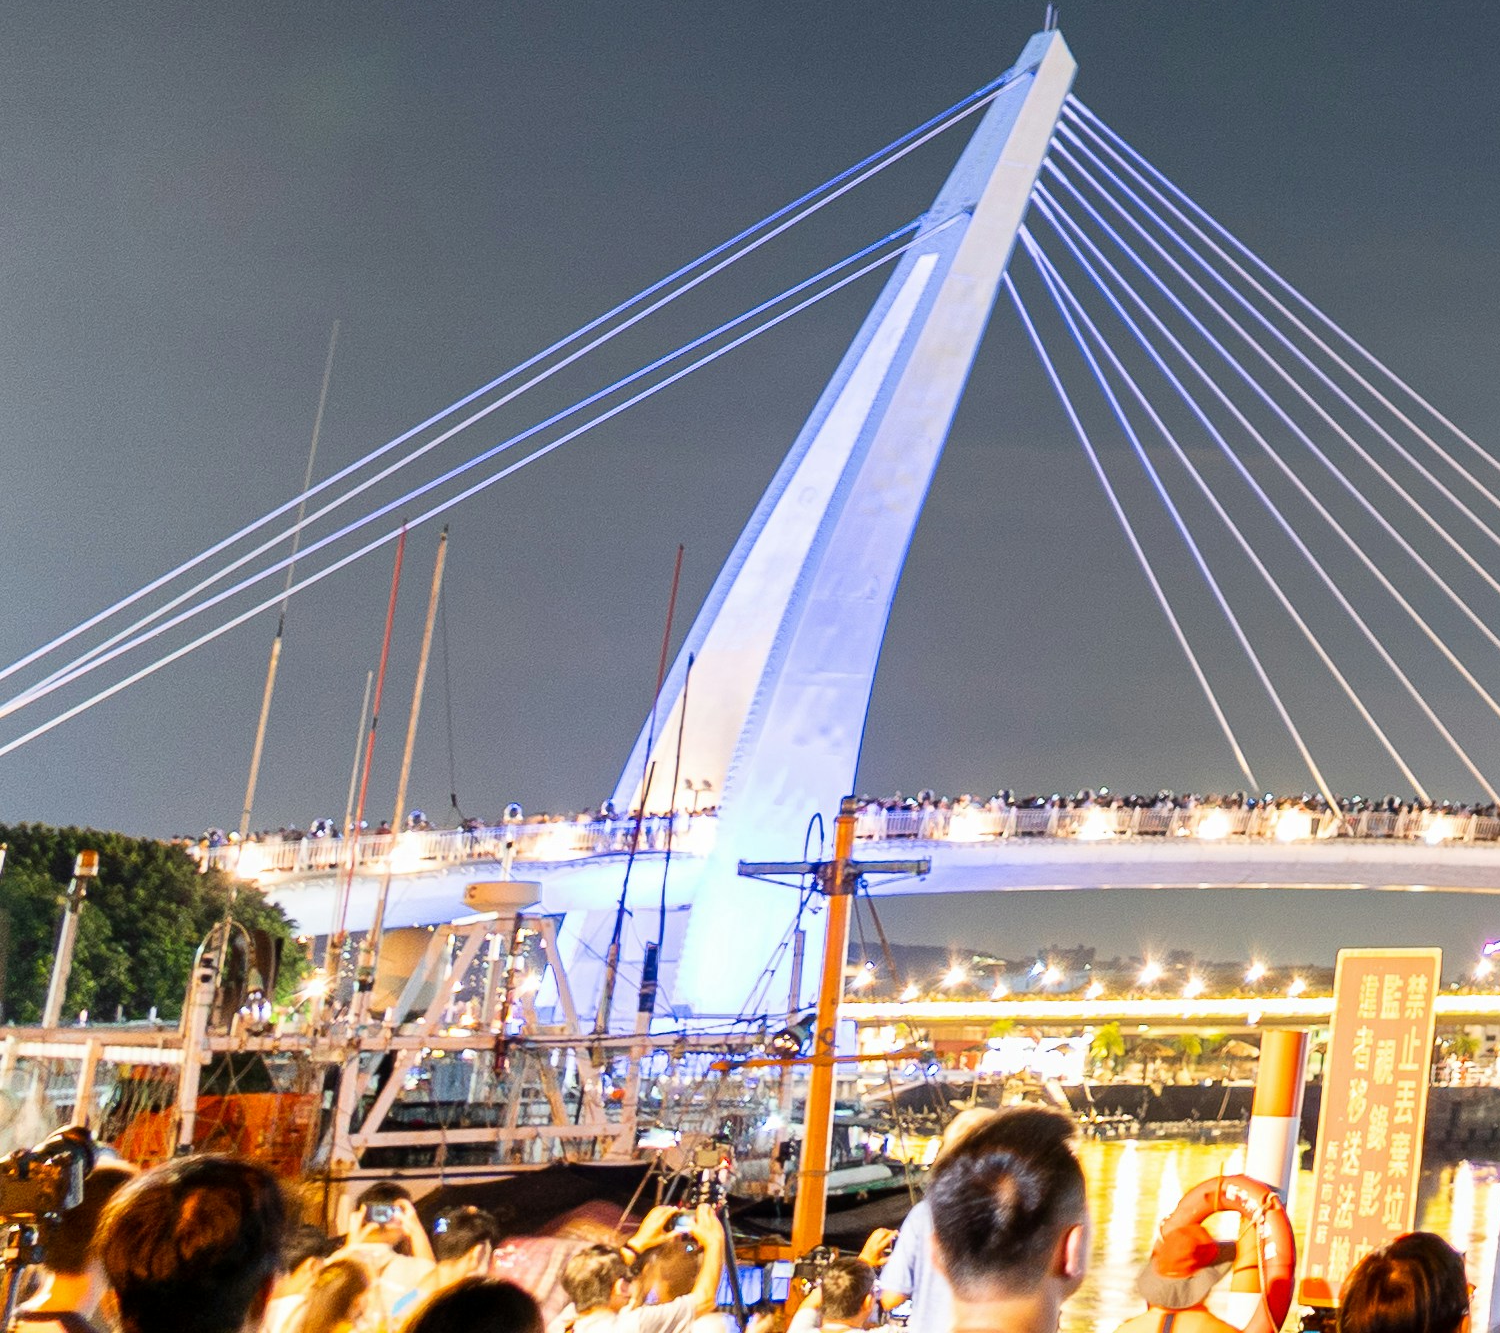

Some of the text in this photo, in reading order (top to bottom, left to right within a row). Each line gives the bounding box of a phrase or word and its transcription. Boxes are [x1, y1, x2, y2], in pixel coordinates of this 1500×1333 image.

[1380, 974, 1428, 1244] 禁止丟棄垃
